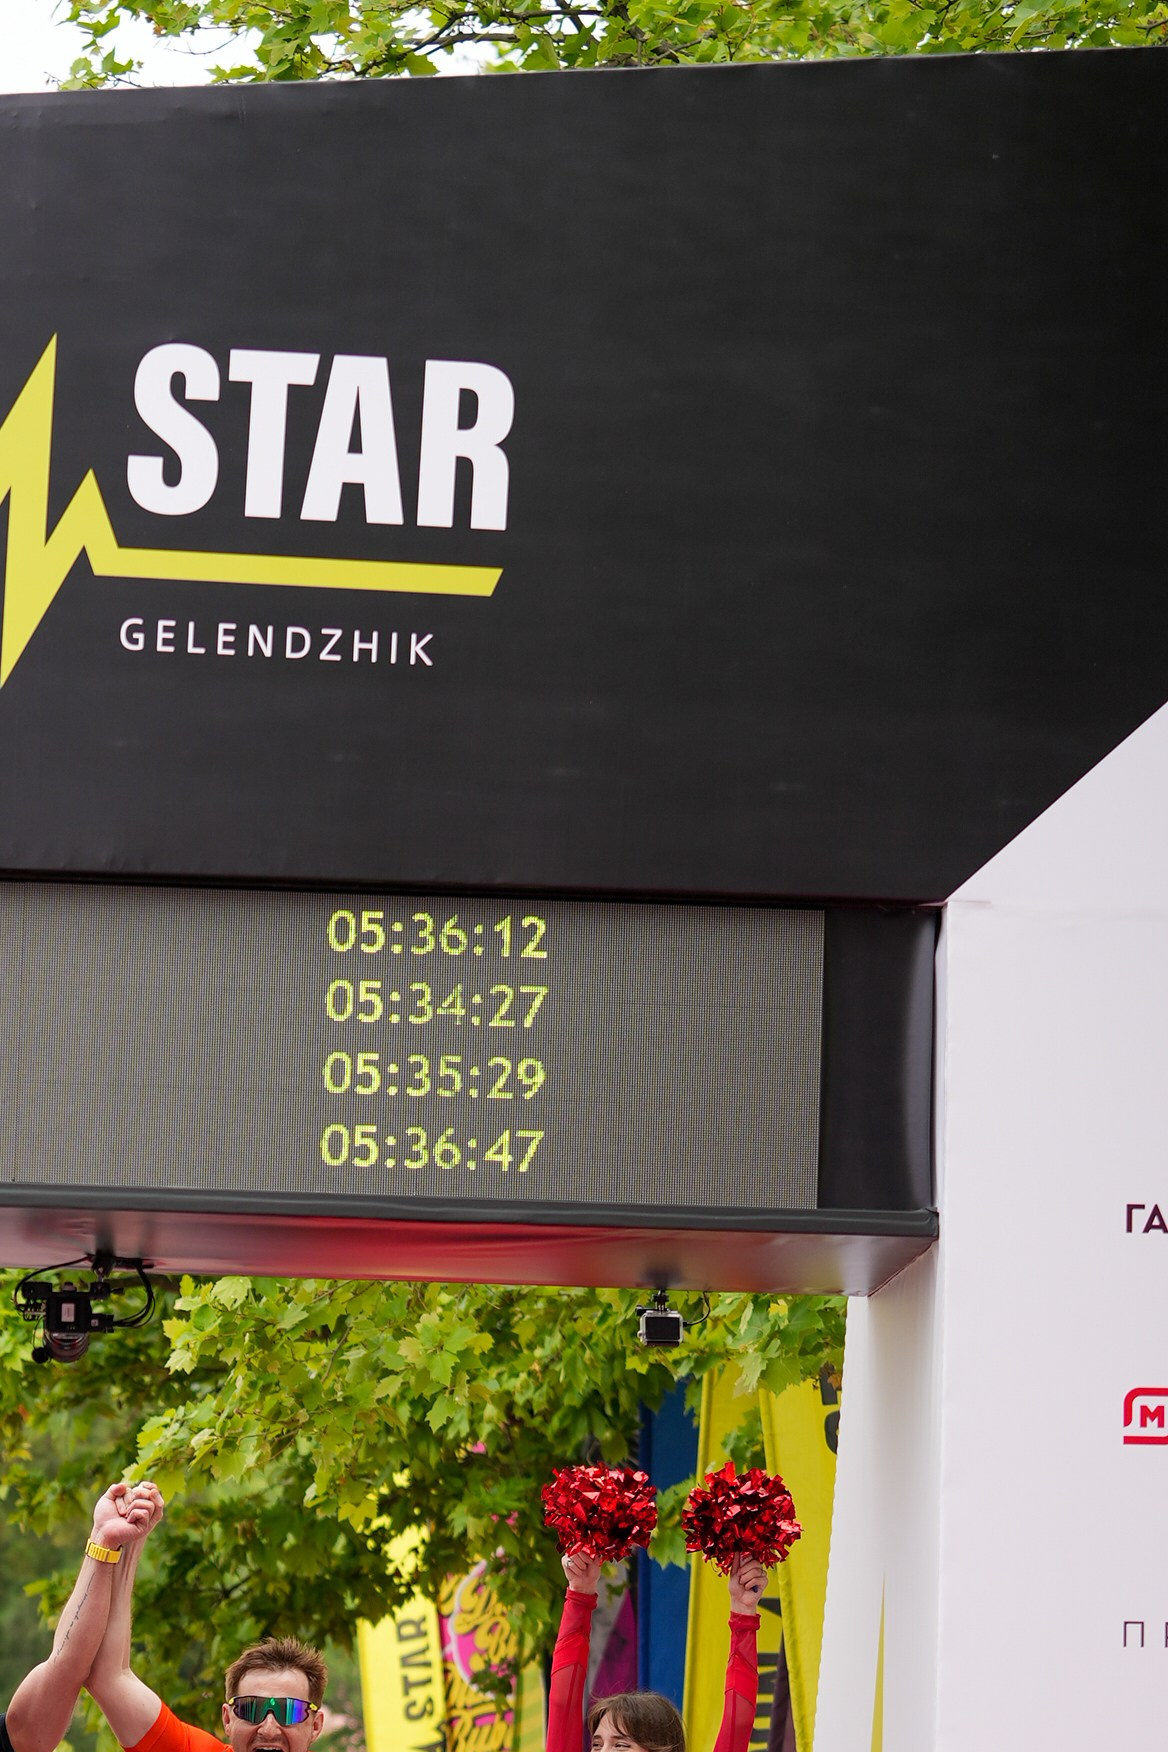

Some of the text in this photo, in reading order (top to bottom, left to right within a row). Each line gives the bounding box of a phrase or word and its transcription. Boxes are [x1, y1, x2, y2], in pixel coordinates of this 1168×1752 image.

[127, 343, 516, 531] STAR
[119, 618, 434, 667] GELENDZHIK
[327, 909, 548, 958] 05:36:12
[325, 979, 549, 1028] 05:34:27
[322, 1052, 547, 1100] 05:35:29
[320, 1123, 545, 1172] 05:36:47
[397, 1614, 435, 1722] STAR
